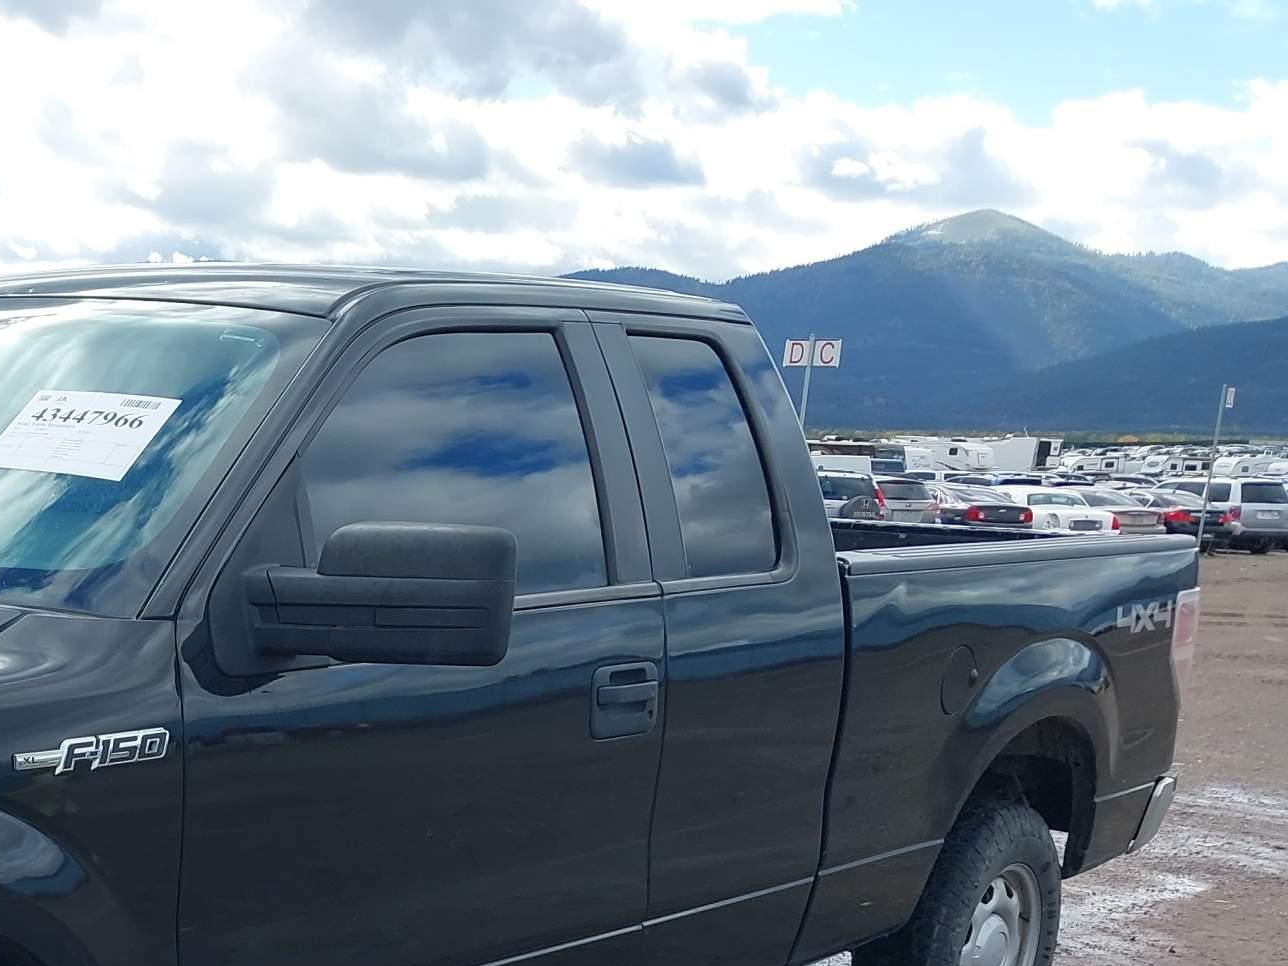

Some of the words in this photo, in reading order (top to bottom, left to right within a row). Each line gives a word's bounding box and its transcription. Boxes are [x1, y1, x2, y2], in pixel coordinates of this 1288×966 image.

[789, 342, 805, 364] D
[820, 342, 835, 364] C
[32, 407, 150, 430] 43447966
[23, 756, 39, 765] XL
